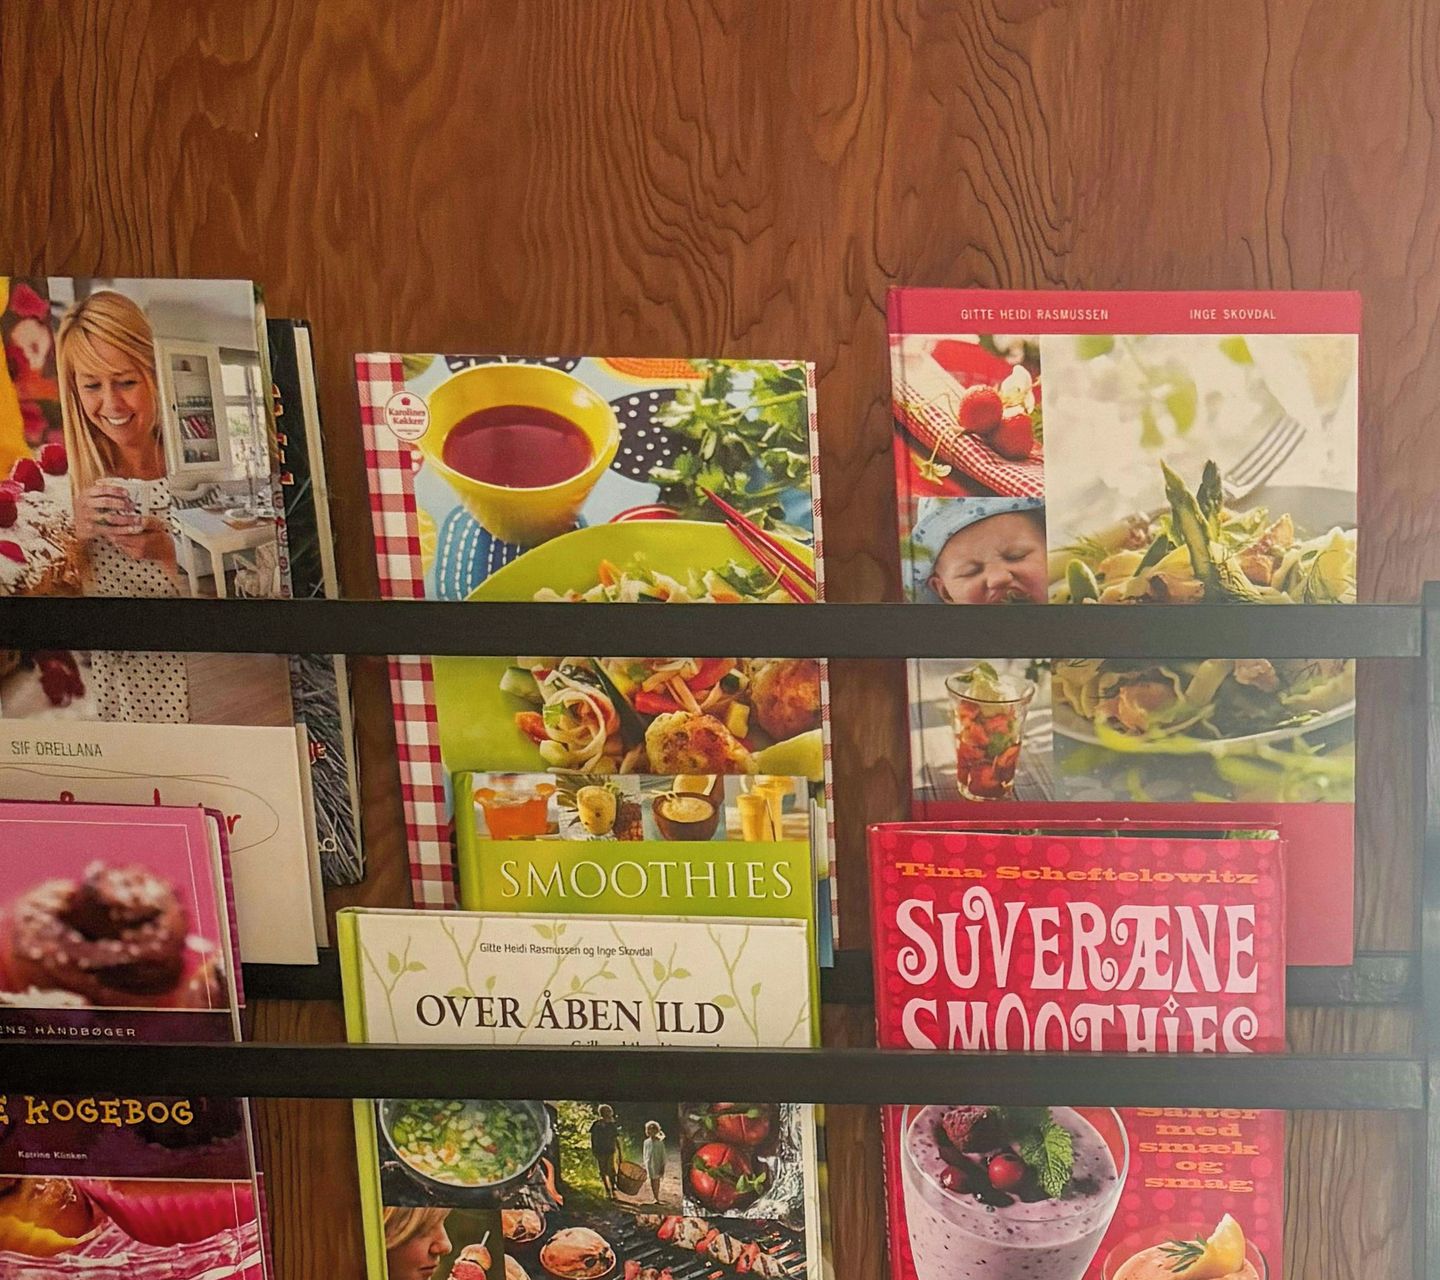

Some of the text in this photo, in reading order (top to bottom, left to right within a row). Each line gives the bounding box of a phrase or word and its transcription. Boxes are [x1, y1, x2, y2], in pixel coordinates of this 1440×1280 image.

[961, 308, 1108, 320] GITTE HEIDI RASMUSSEN
[1190, 309, 1277, 320] INGE SKOVDAL
[11, 740, 103, 757] SIF ORELLANA
[500, 860, 793, 899] SMOOTHIES
[896, 862, 1259, 884] Tina Scheftelowitz
[896, 885, 1259, 993] SUVERÆNE
[479, 942, 653, 958] Gitte Heidi Rasmussen og Inge Skovdal
[416, 989, 725, 1034] OVER ÅBEN ILD
[35, 1025, 136, 1037] HÅNDBØGER
[24, 1095, 194, 1127] KOGEBOG
[1155, 1123, 1242, 1137] med
[1138, 1141, 1260, 1155] smæk
[1175, 1160, 1224, 1175] og
[1144, 1177, 1254, 1193] smag
